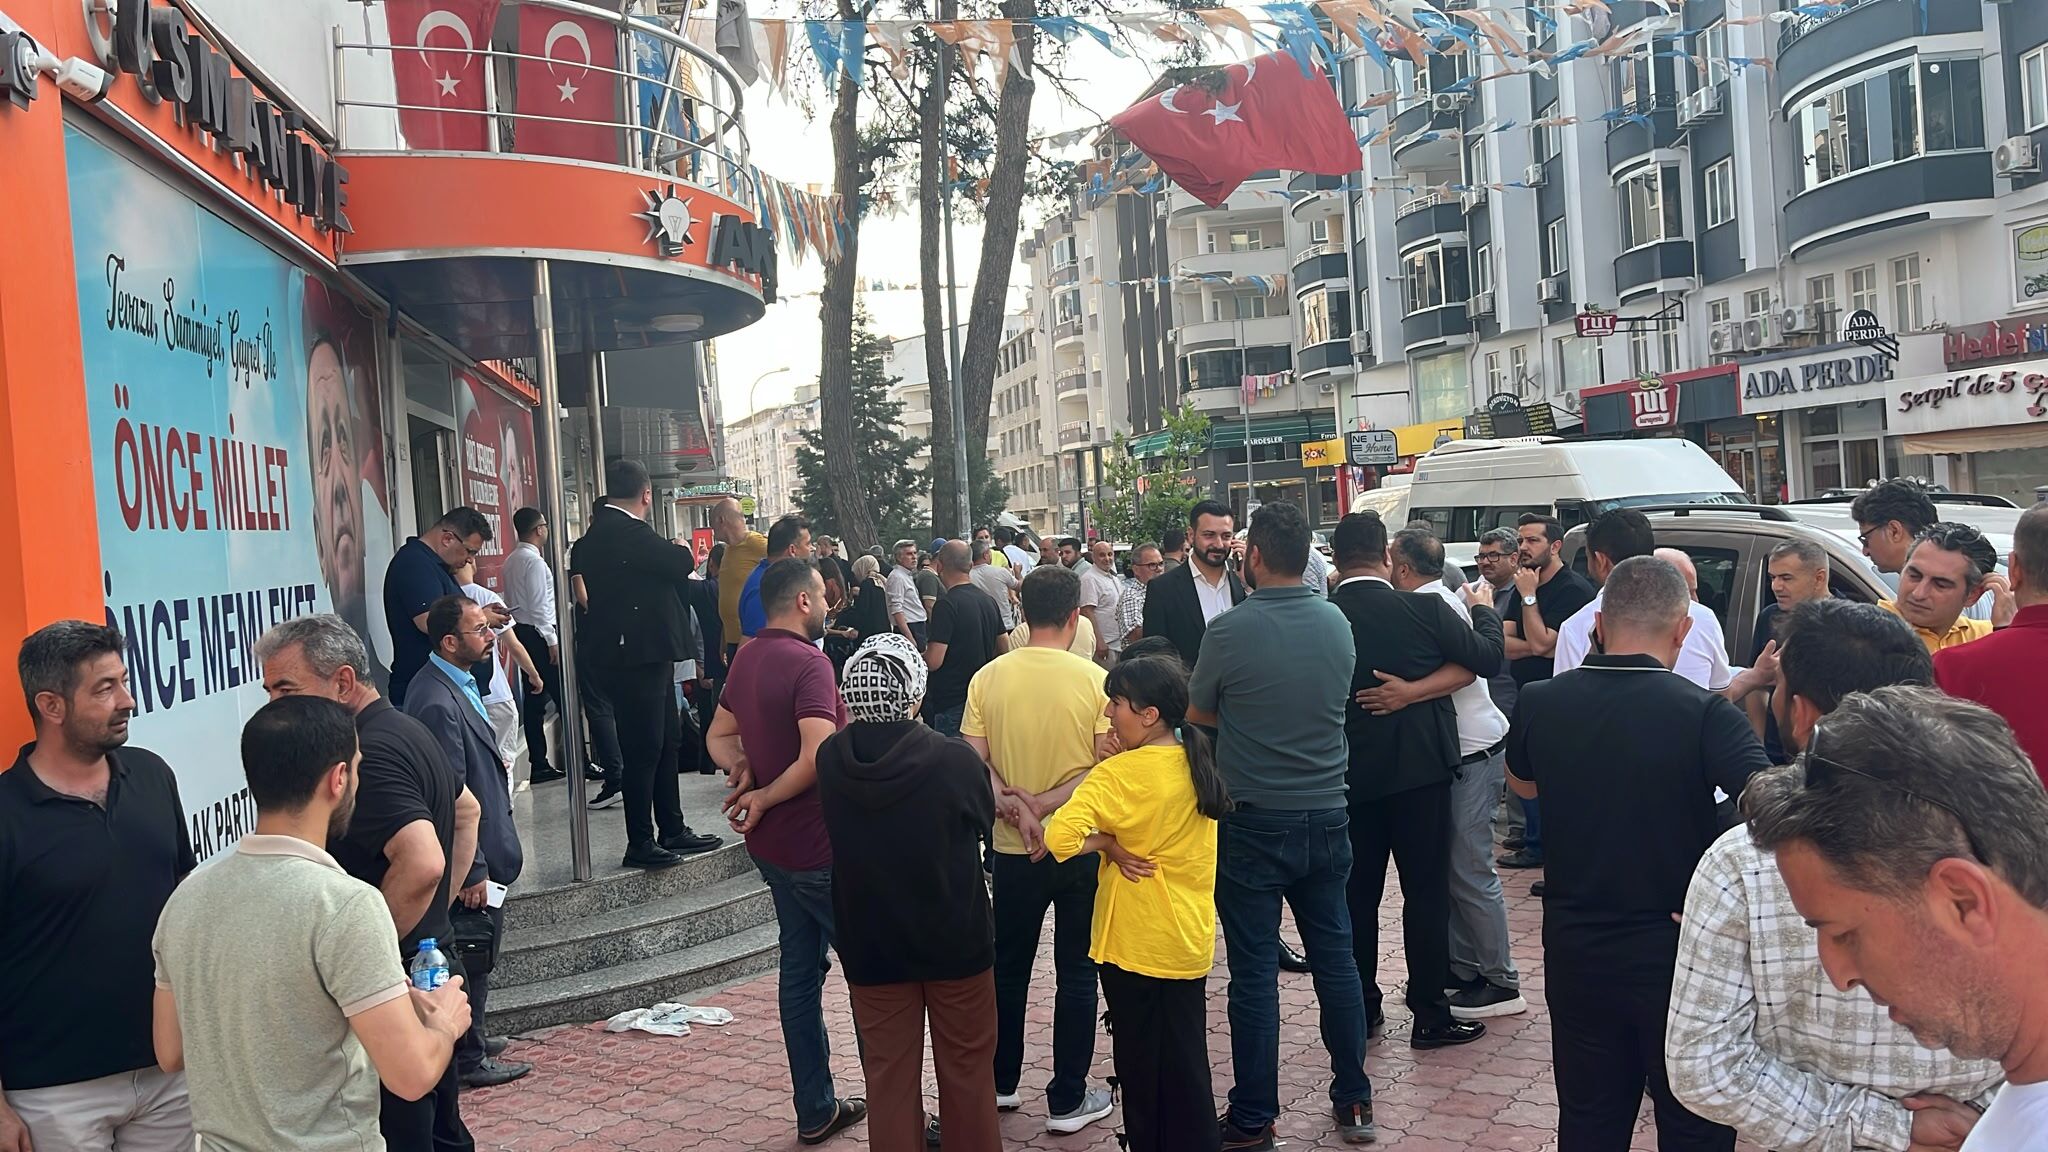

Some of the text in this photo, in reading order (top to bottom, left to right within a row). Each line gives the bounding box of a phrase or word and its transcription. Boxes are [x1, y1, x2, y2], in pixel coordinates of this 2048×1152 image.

[106, 253, 158, 345] Tevazu,
[1579, 315, 1613, 330] TUT
[1850, 316, 1877, 328] ADA
[1845, 328, 1886, 342] PERDE
[1743, 352, 1894, 400] ADA PERDE
[1996, 371, 2017, 394] 5
[1630, 387, 1669, 415] TUT
[114, 383, 290, 532] ÖNCE MİLLET
[1364, 441, 1393, 454] Home
[193, 806, 214, 863] AK
